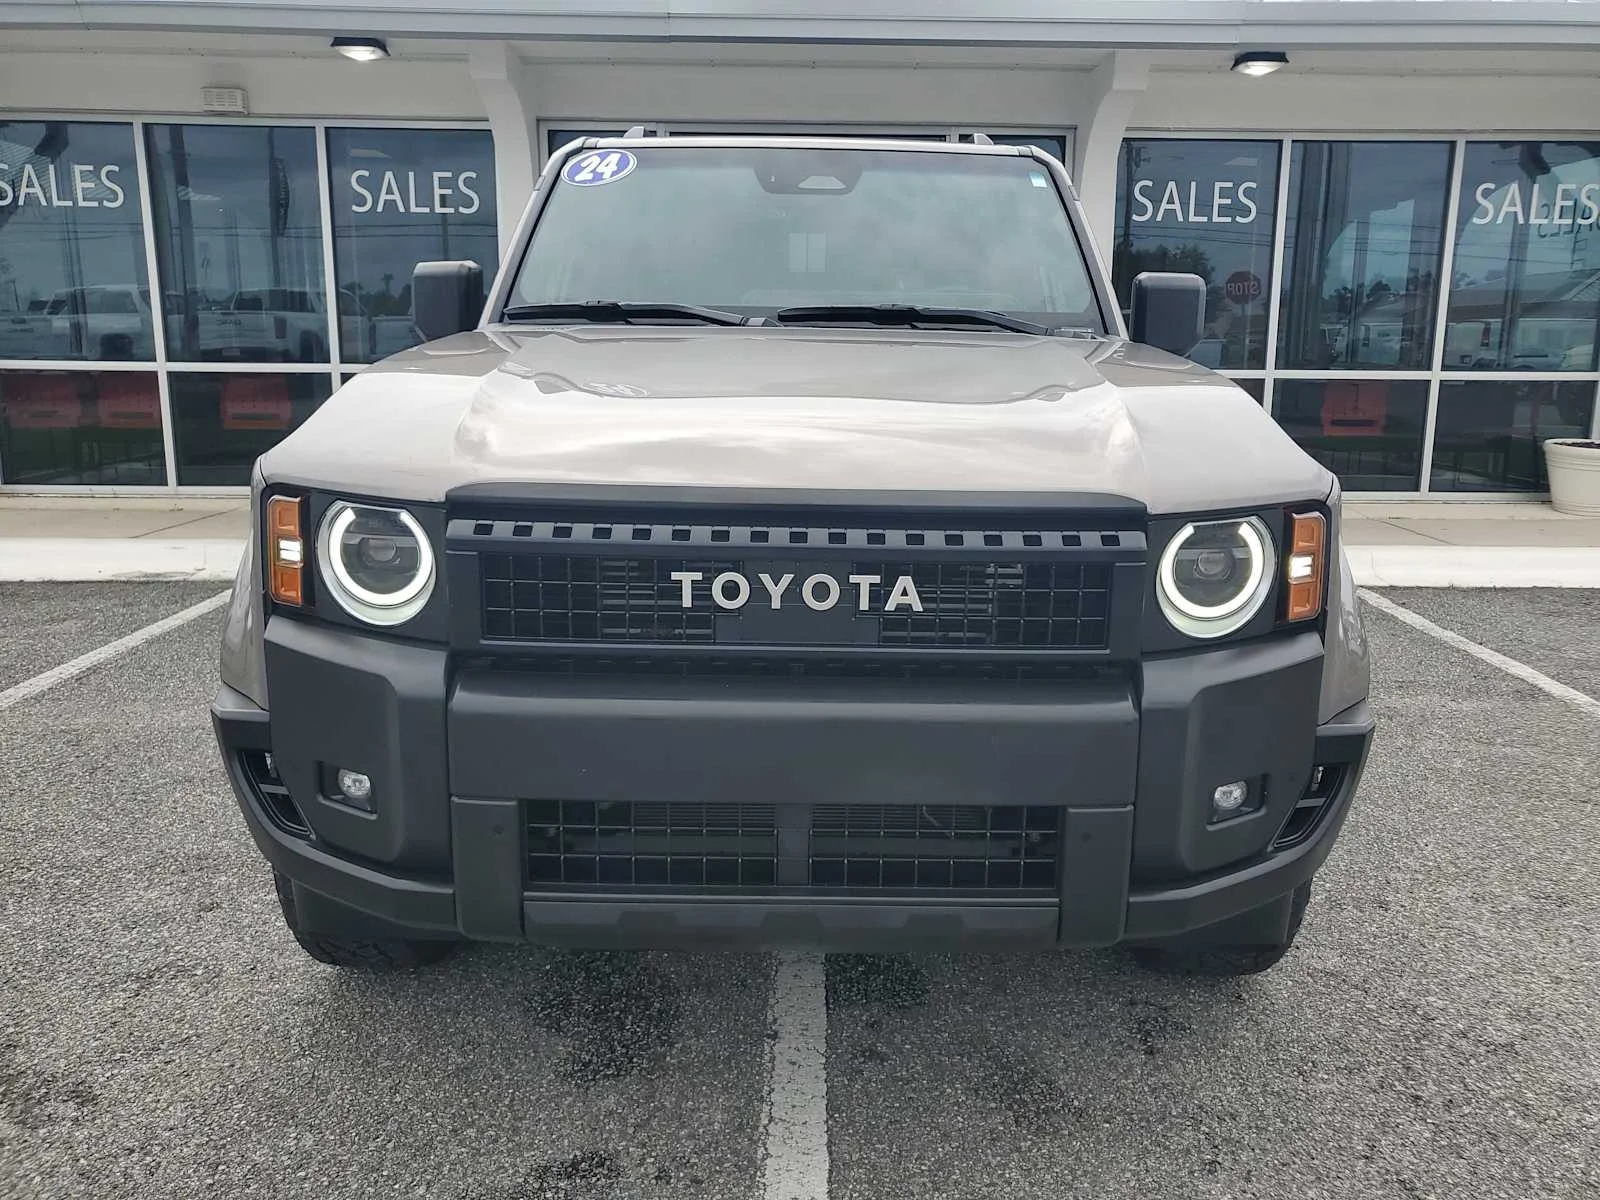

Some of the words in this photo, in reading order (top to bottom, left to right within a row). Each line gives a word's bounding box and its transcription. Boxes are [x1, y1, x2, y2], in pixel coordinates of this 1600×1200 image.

[574, 153, 622, 182] 24
[350, 169, 480, 214] SALES
[1131, 179, 1257, 223] SALES
[1472, 182, 1600, 225] SALES
[670, 571, 923, 612] TOYOTA
